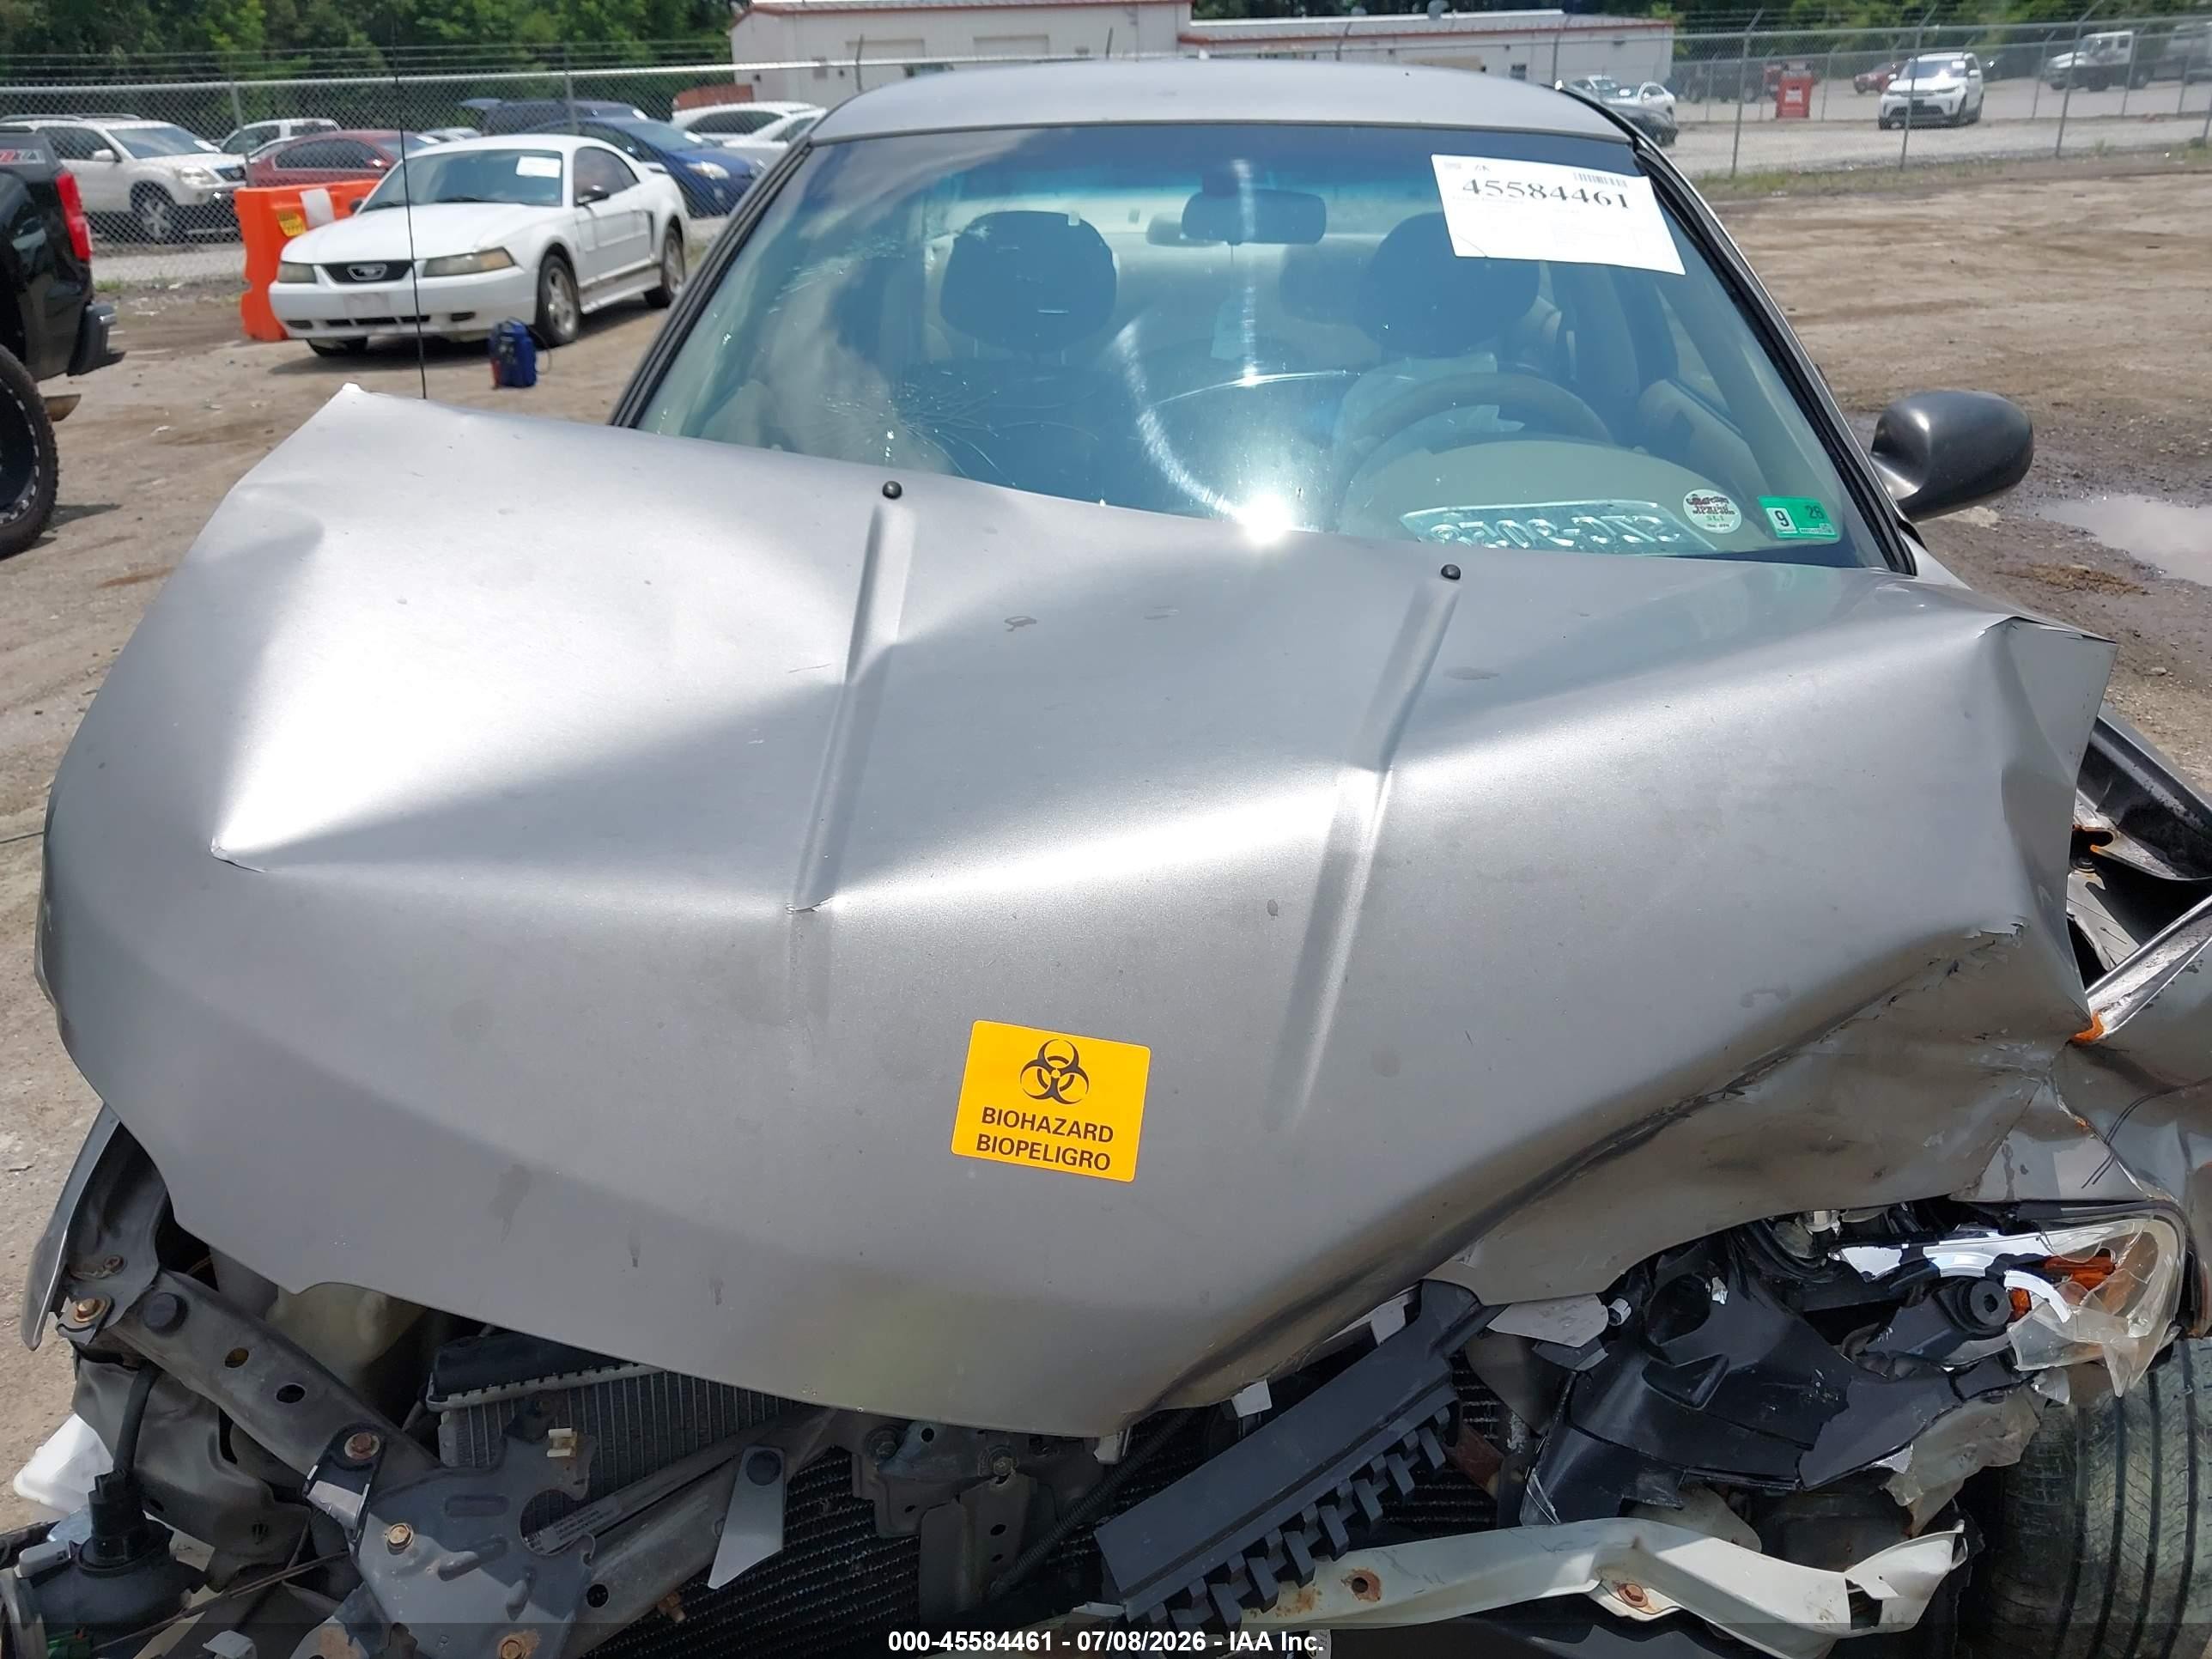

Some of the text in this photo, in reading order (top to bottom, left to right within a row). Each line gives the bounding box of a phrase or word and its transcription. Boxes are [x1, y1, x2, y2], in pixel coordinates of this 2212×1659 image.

[1462, 178, 1629, 209] 45584461
[1774, 510, 1790, 526] 9
[981, 1107, 1114, 1143] BIOHAZARD
[976, 1133, 1111, 1171] BIOPELIGRO
